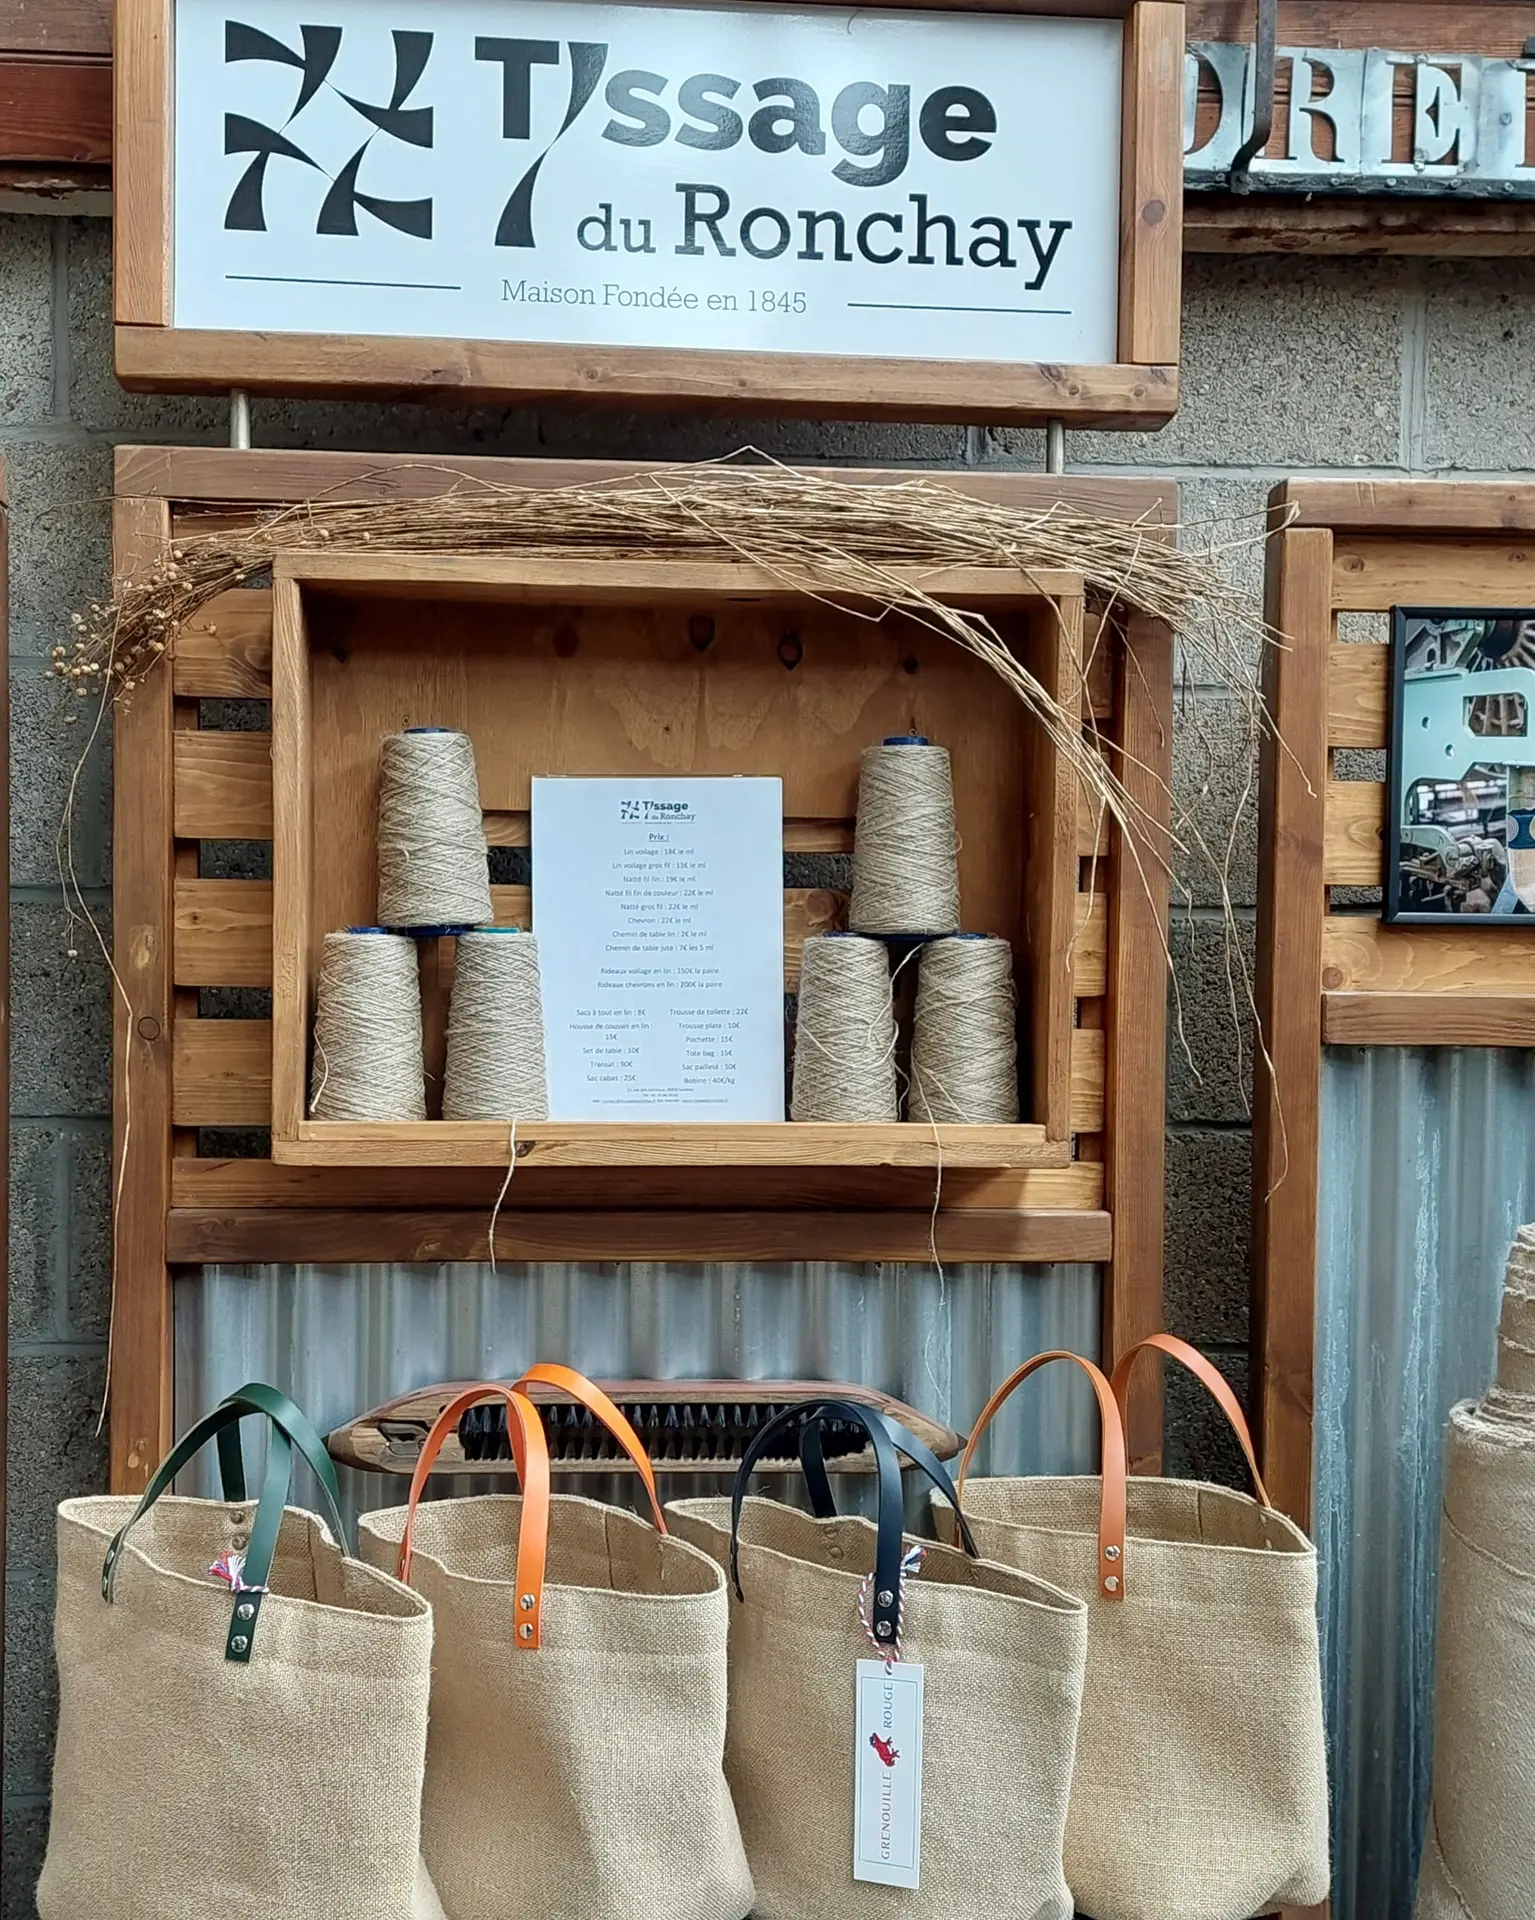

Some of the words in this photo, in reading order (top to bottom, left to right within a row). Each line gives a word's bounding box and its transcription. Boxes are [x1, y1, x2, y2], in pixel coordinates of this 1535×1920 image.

[475, 37, 997, 248] Tissage
[577, 203, 655, 254] du
[676, 184, 1073, 291] Ronchay
[502, 279, 596, 306] Maison
[603, 283, 699, 309] Fondée
[707, 294, 740, 311] en
[747, 289, 808, 315] 1845
[660, 812, 696, 821] Ronchay
[883, 1682, 894, 1729] ROUGE
[881, 1771, 892, 1861] GRENOUILLE
